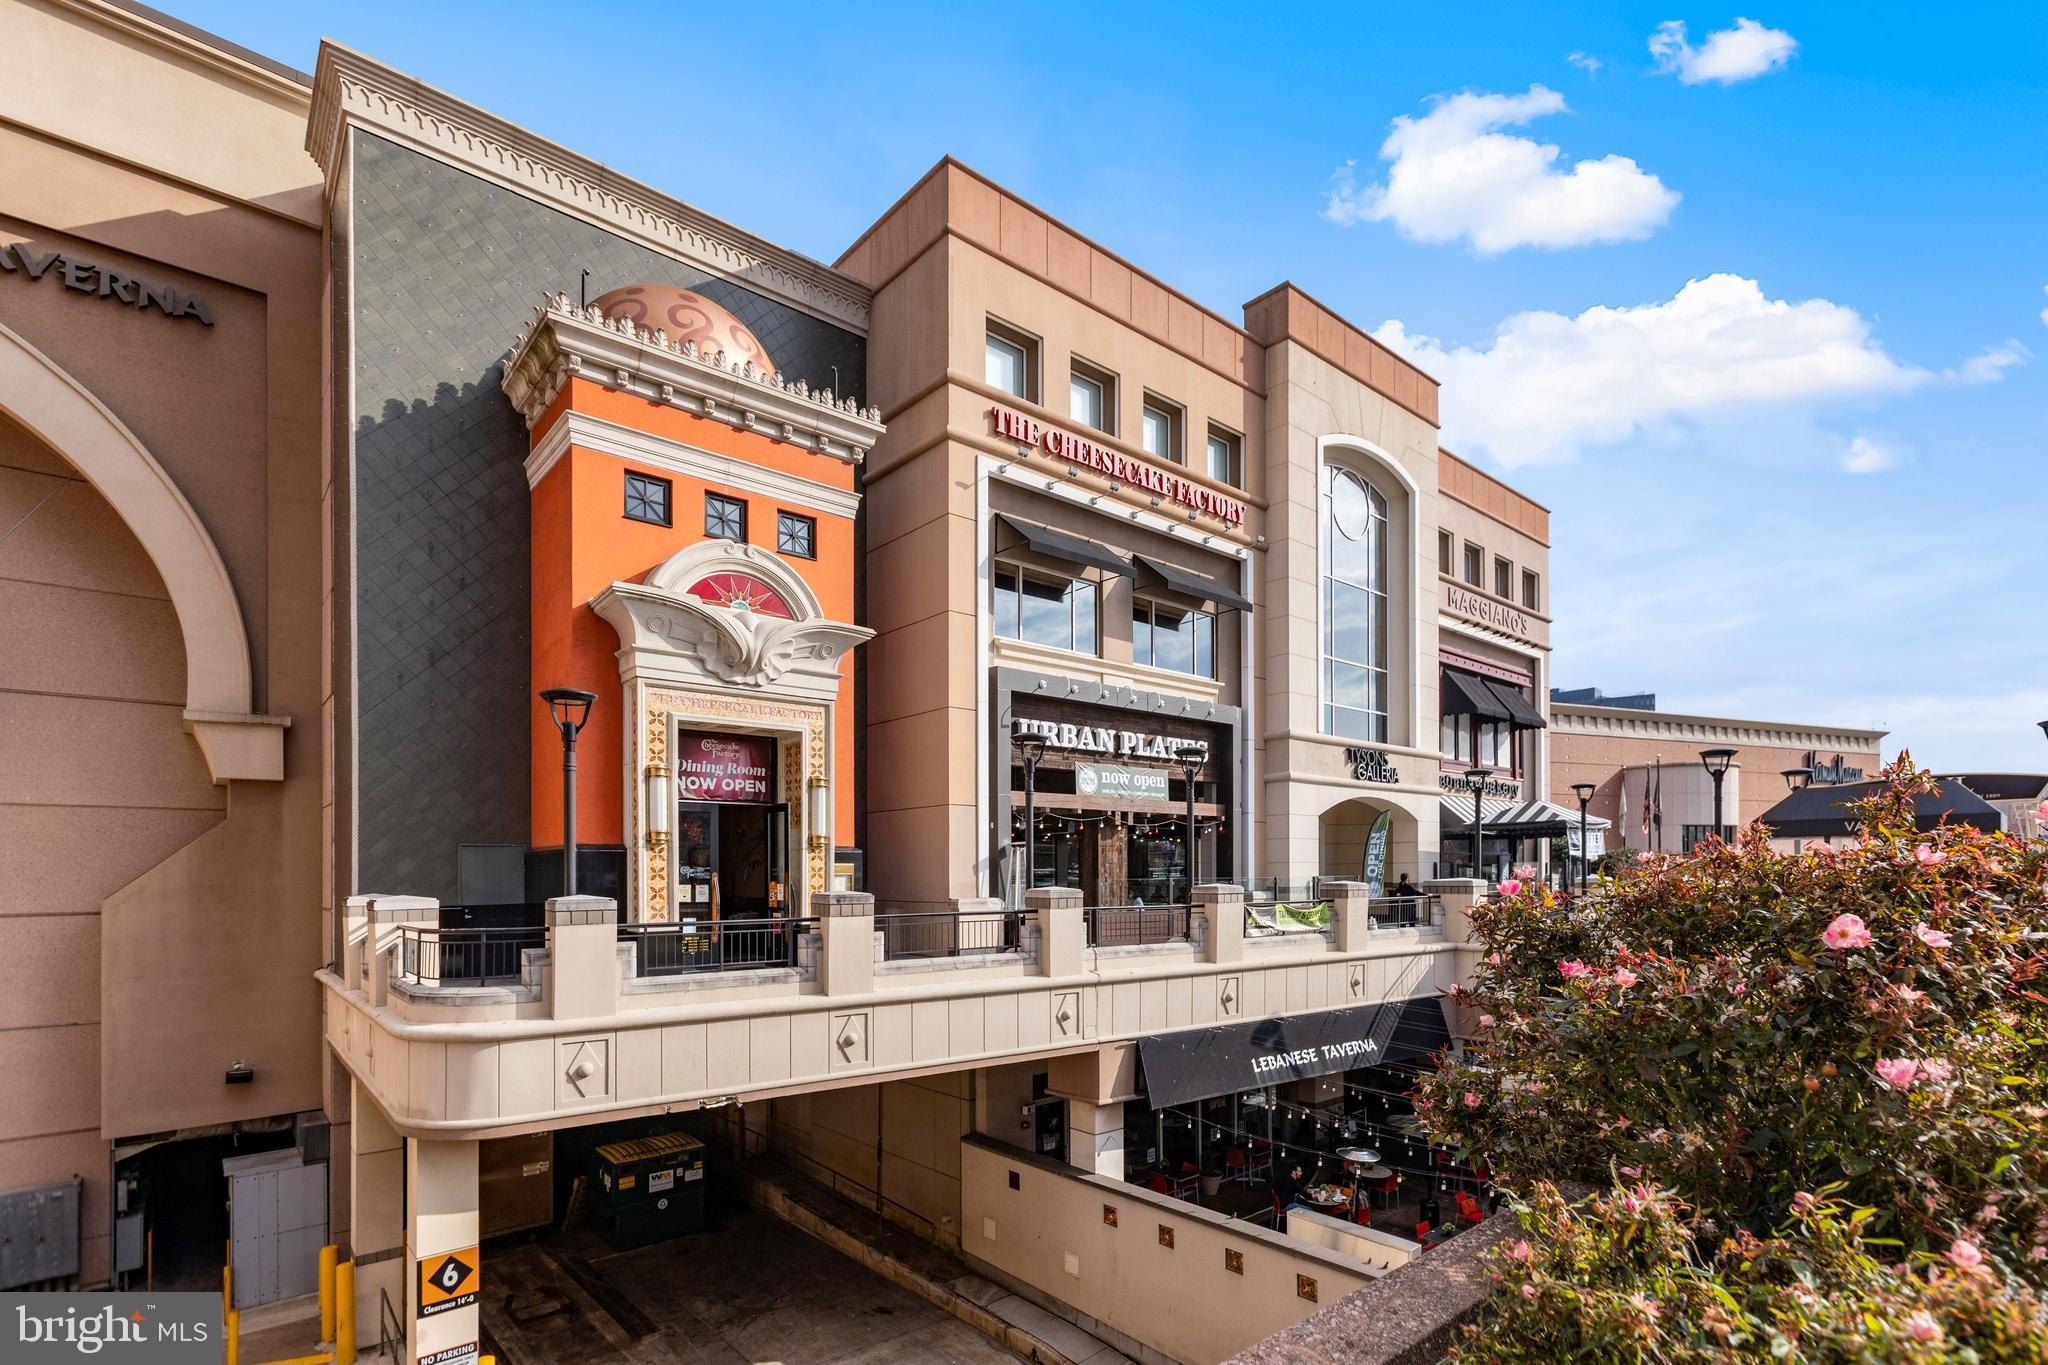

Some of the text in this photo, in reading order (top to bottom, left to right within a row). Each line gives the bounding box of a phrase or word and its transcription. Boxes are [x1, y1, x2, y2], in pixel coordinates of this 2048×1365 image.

[992, 406, 1247, 526] THE CHEESECAKE FACTORY
[1448, 586, 1527, 635] MAGGIANO'S
[701, 739, 740, 751] Cheesecake
[1019, 718, 1209, 763] URBAN PLATES
[712, 750, 740, 760] Factory
[1348, 747, 1388, 767] TYSONS
[677, 759, 765, 776] Dining Room
[1356, 763, 1400, 783] GALLERIA
[677, 776, 766, 793] NOW OPEN
[1101, 771, 1130, 785] now
[1134, 775, 1165, 789] open
[1367, 832, 1381, 877] OPEN
[1251, 1037, 1378, 1073] LEBANESE TAVERNA
[442, 1262, 458, 1287] 6
[424, 1302, 456, 1315] Clearance
[420, 1356, 434, 1365] NO
[436, 1343, 475, 1364] PARKING
